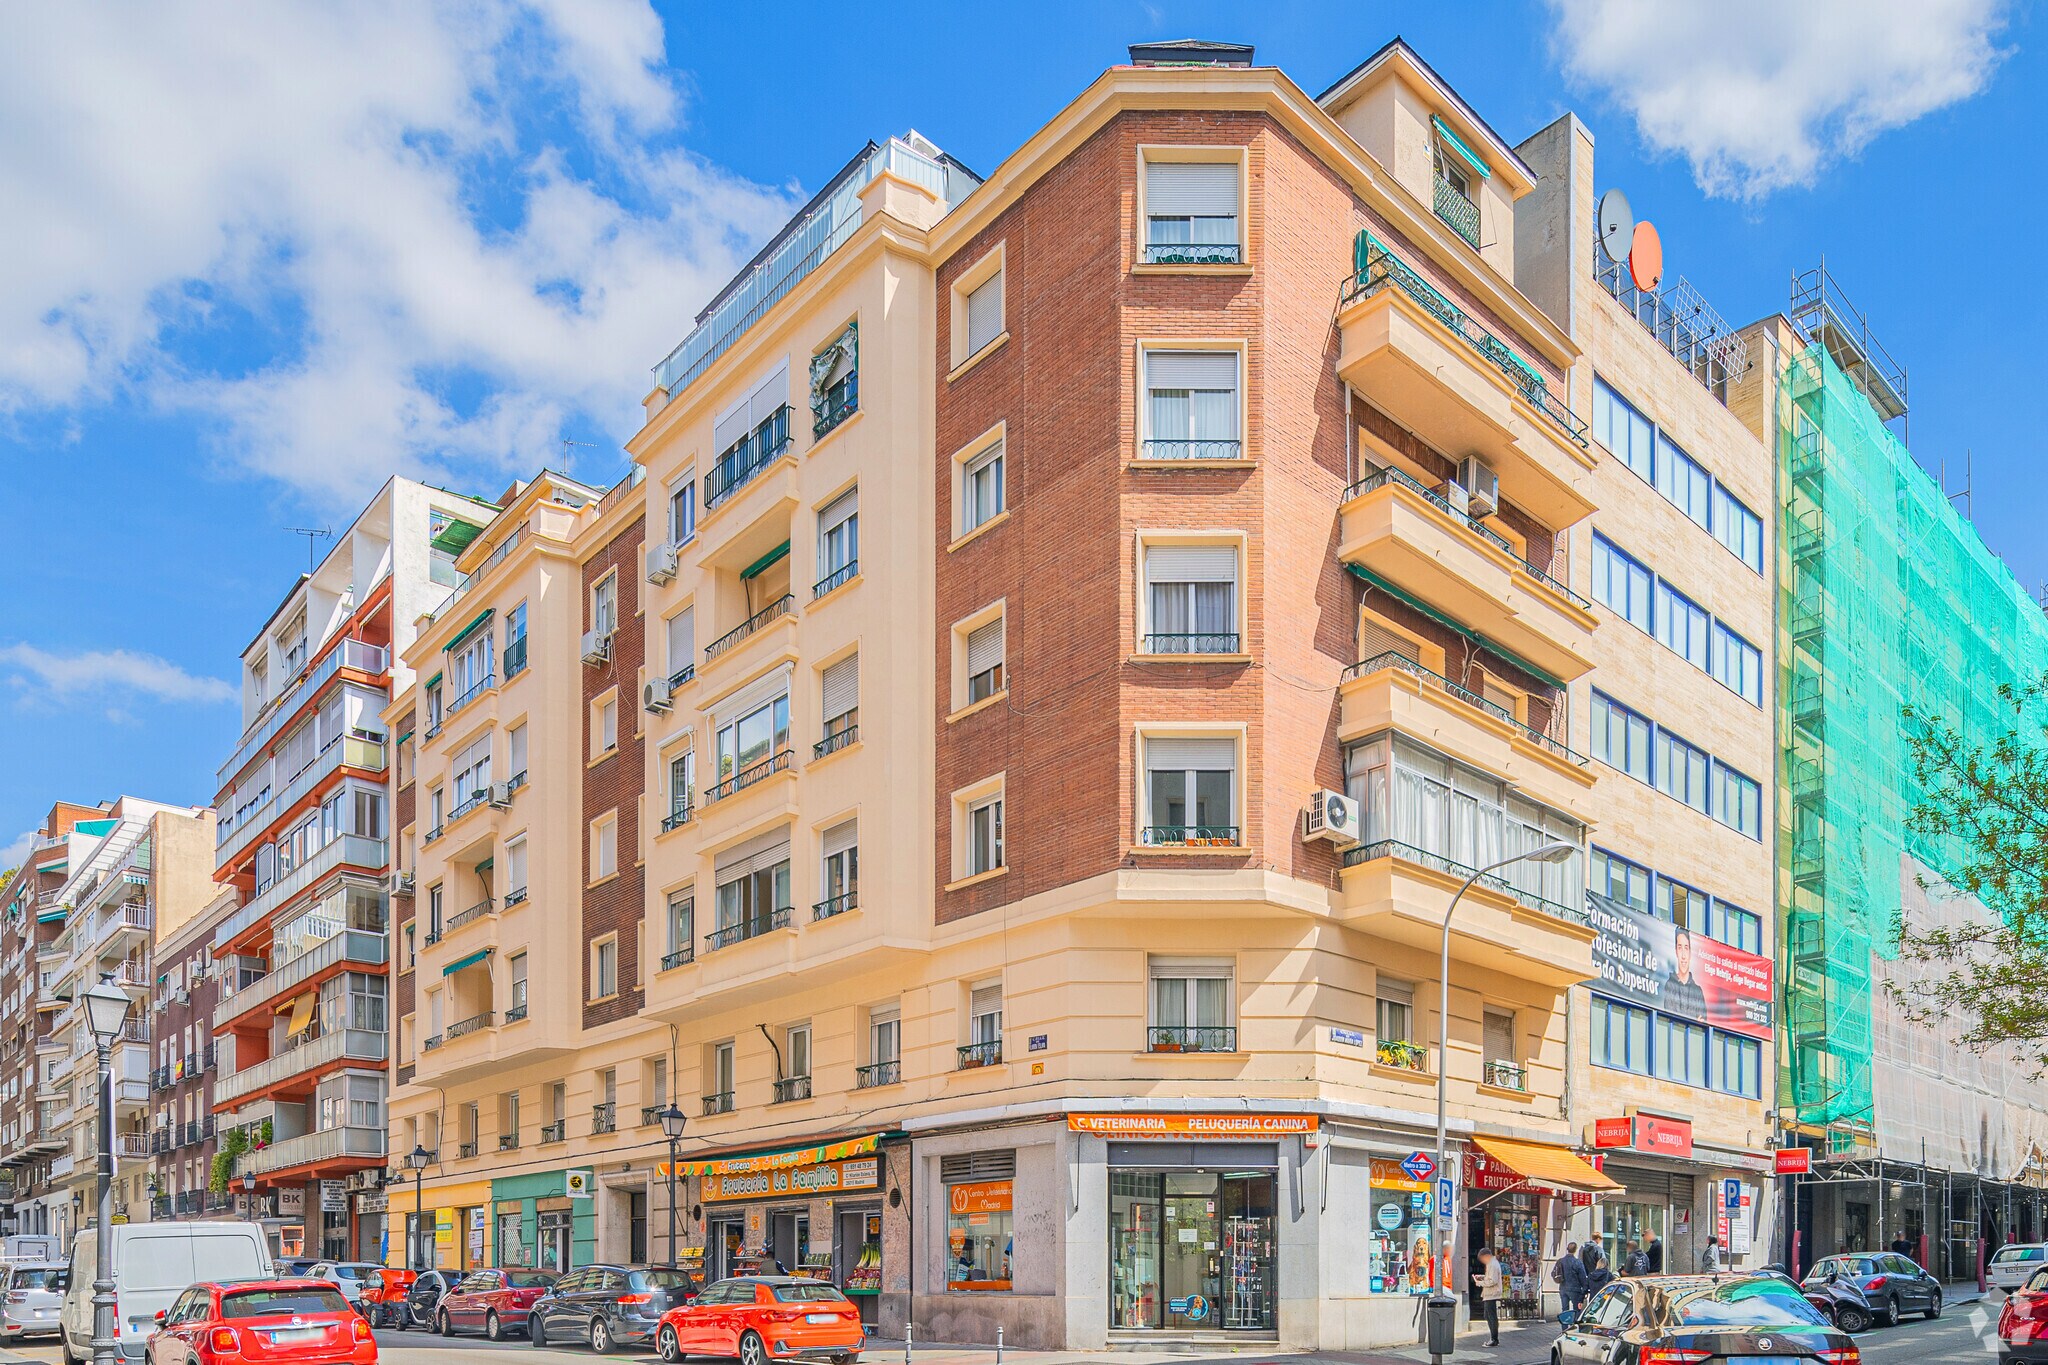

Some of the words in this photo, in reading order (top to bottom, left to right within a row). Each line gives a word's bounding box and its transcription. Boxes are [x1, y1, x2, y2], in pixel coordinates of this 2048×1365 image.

[1585, 901, 1639, 940] Formación
[1592, 934, 1643, 966] rofesional
[1645, 951, 1657, 971] de
[1592, 959, 1615, 980] rado
[1617, 964, 1659, 995] Superior
[1077, 1118, 1088, 1129] C.
[1090, 1118, 1166, 1129] VETERINARIA
[1188, 1117, 1261, 1131] PELUQUERÍA
[1263, 1118, 1309, 1130] CANINA
[1597, 1129, 1629, 1138] NEBRIJA
[1657, 1132, 1683, 1147] NEBRIJA
[1778, 1159, 1806, 1167] NEBRIJA
[722, 1171, 769, 1196] Frutería
[773, 1171, 788, 1191] La
[791, 1165, 838, 1192] Familia
[1484, 1175, 1514, 1188] FRUTOS
[282, 1194, 300, 1203] BK
